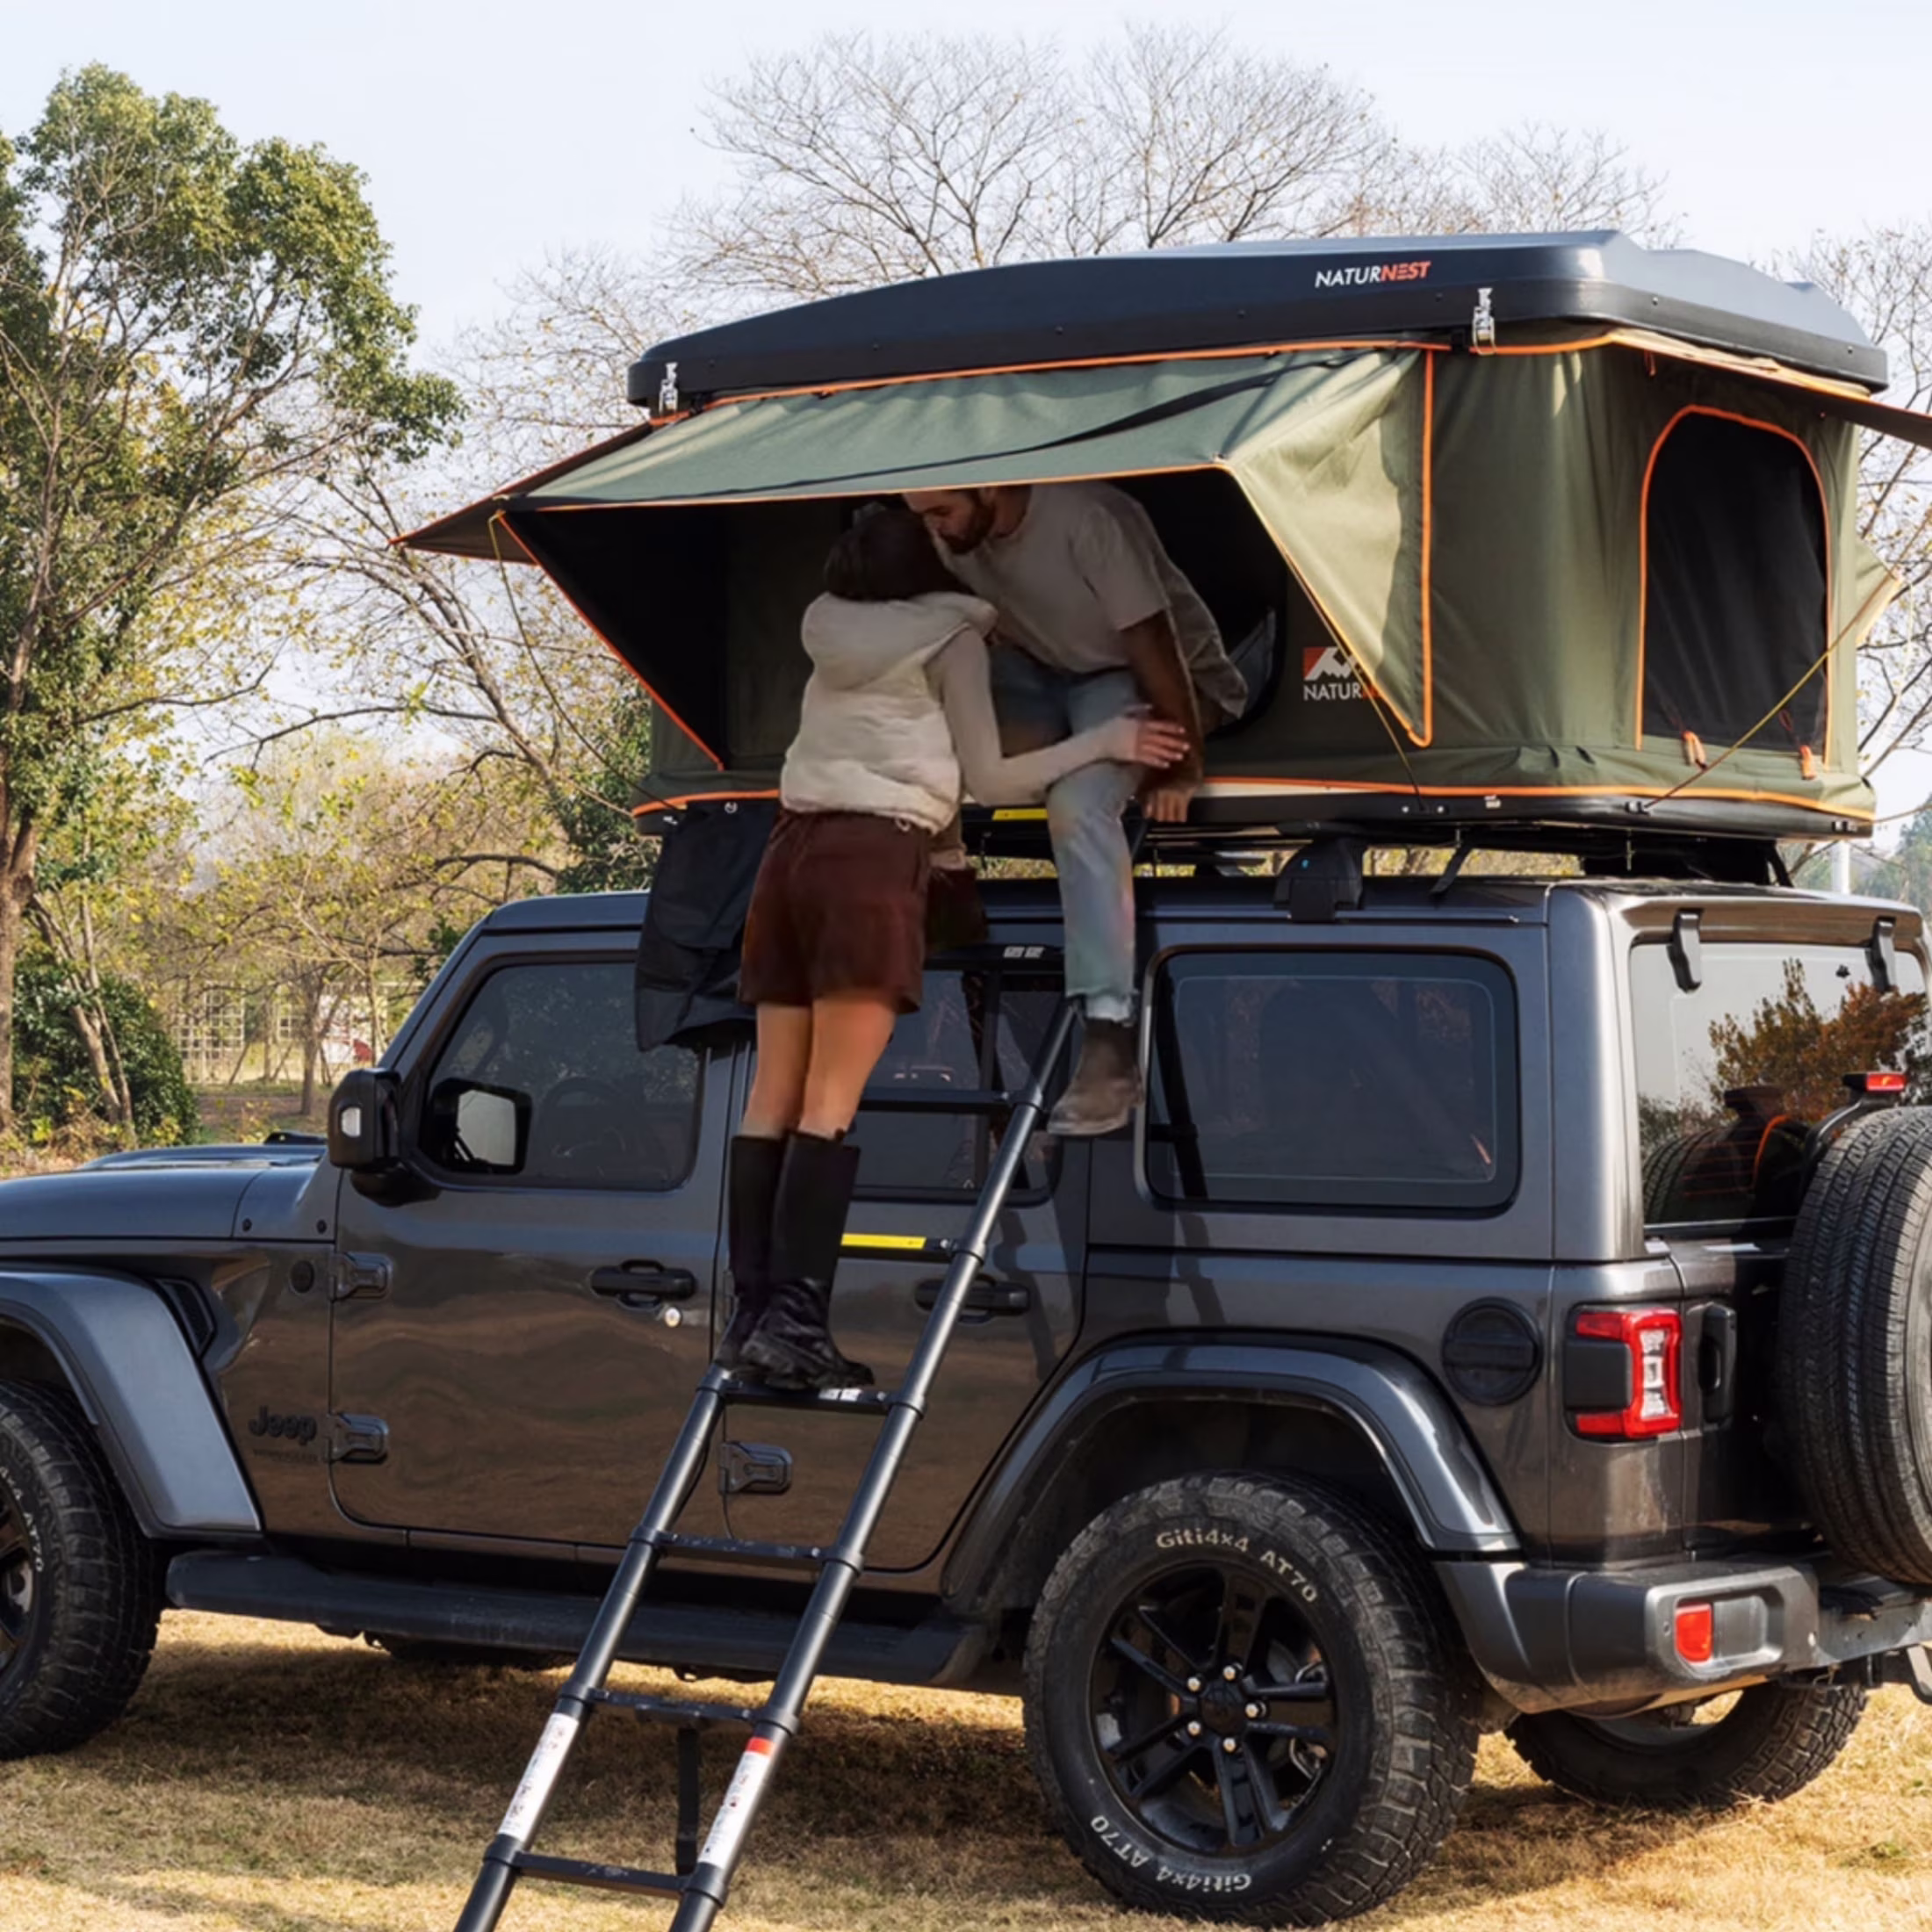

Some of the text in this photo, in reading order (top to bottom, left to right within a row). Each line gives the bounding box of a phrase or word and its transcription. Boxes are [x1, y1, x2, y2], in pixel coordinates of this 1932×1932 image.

[1315, 261, 1431, 288] NATURNEST
[249, 1406, 317, 1445] Jeep
[1156, 1529, 1317, 1603] Giti4x4 AT70
[1090, 1815, 1252, 1892] Giti4x4 AT70
